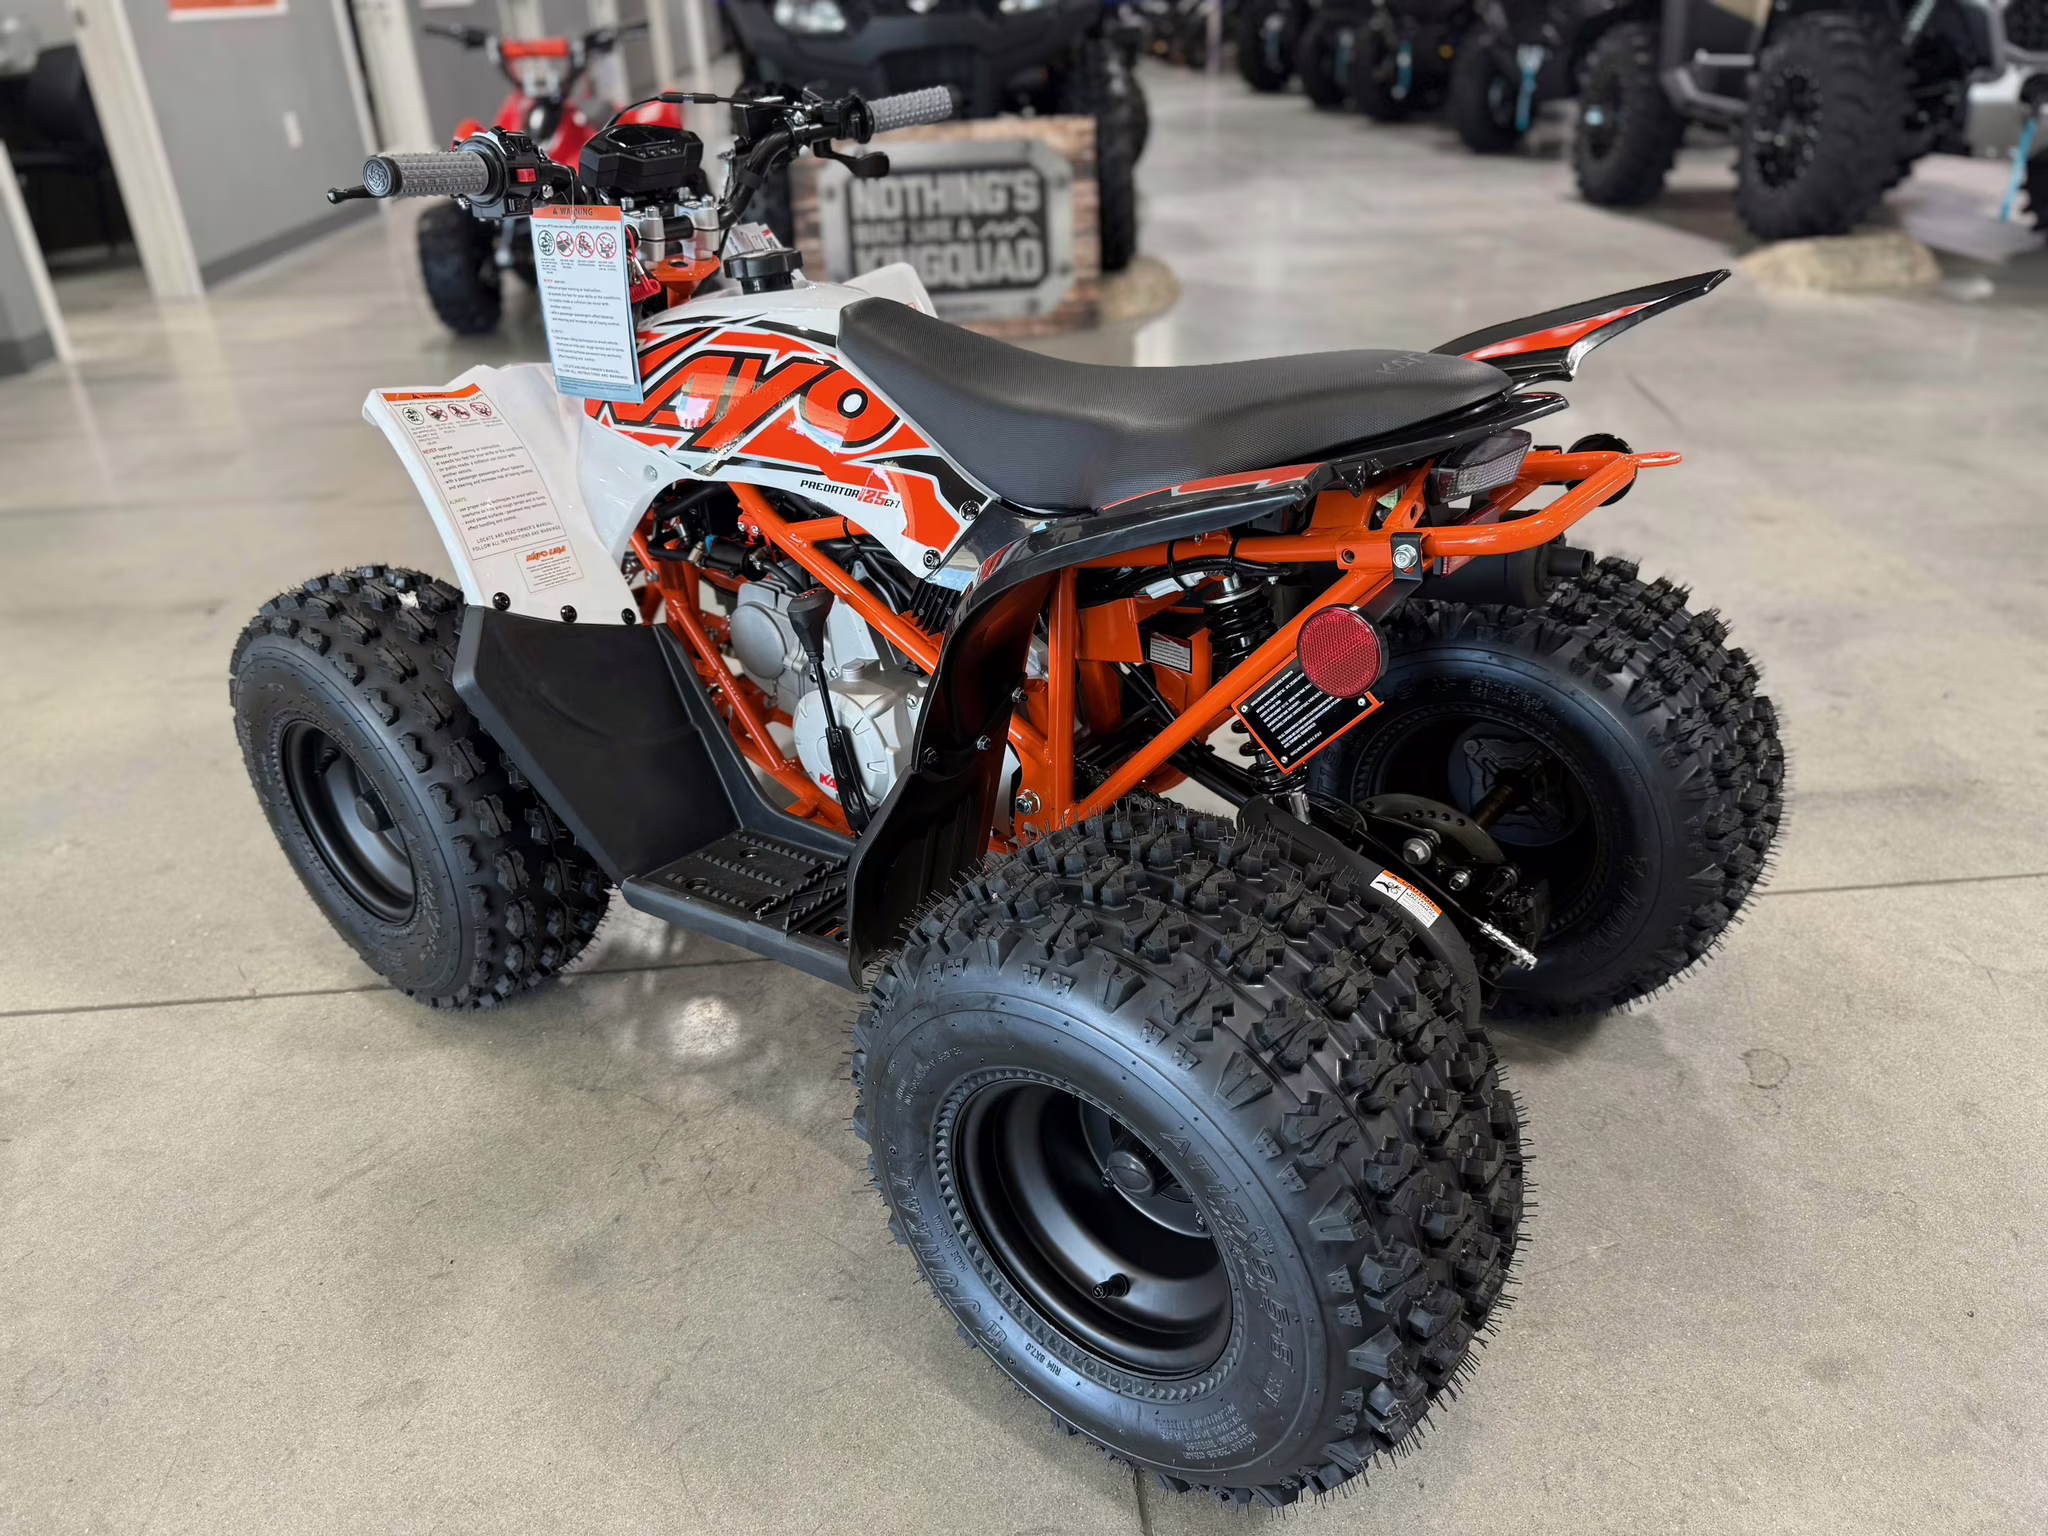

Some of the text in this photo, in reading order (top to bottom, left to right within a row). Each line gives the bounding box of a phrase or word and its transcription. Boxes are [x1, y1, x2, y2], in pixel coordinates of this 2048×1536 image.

[853, 169, 1042, 219] NOTHING'S
[800, 480, 860, 498] PREDATOR
[857, 488, 888, 505] 125
[950, 1250, 968, 1272] MADE
[1025, 1342, 1062, 1377] RIM 8X7.0
